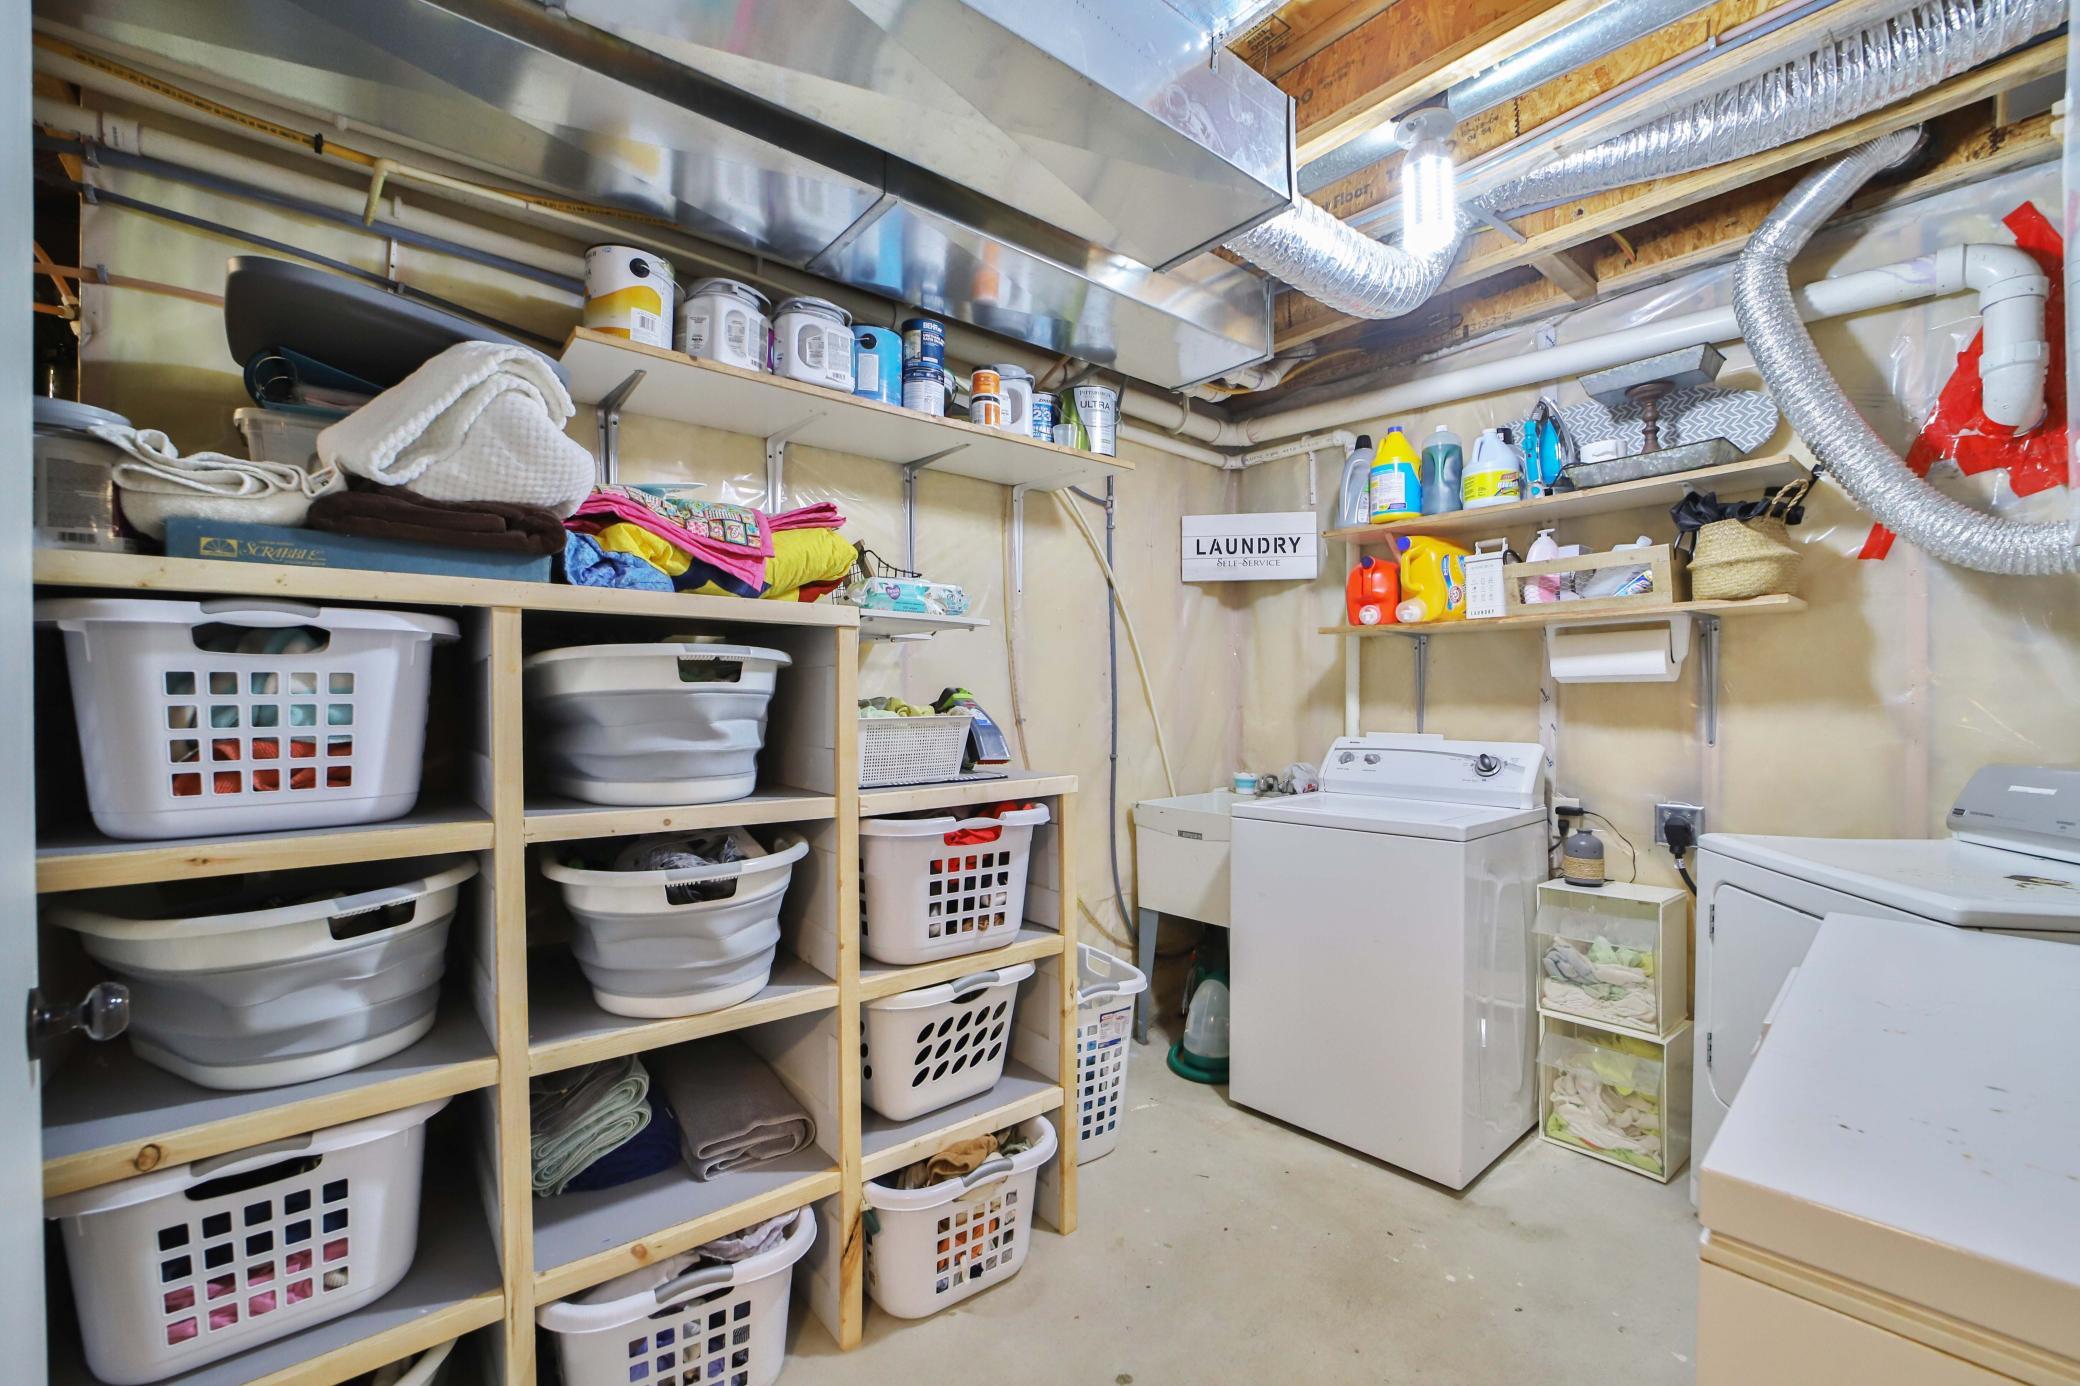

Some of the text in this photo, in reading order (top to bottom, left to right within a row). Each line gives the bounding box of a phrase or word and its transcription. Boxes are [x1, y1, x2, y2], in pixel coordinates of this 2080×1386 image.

[1333, 184, 1371, 208] Floor
[1080, 400, 1110, 410] ULTRA
[244, 541, 318, 562] SCRABBLE
[1196, 537, 1302, 556] LAUNDRY
[1216, 557, 1281, 568] SELF-SERVICE
[1470, 608, 1495, 616] LAUNDRY
